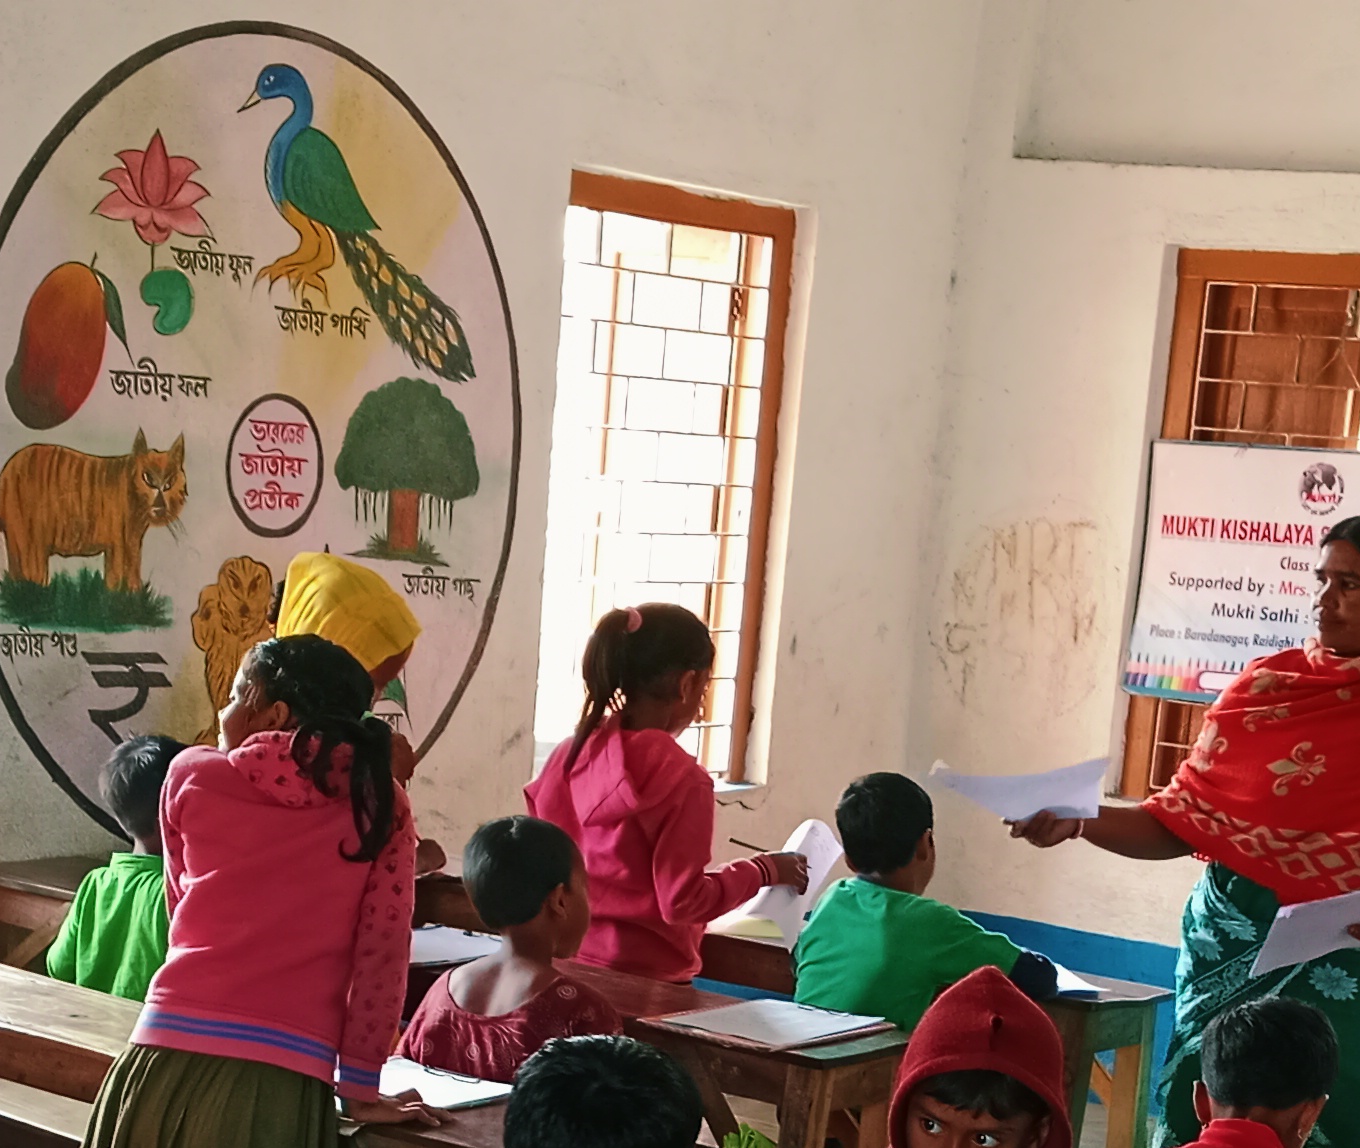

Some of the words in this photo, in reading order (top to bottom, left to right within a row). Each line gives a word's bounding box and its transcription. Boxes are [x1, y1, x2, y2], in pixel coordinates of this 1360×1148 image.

[169, 238, 226, 277] জাতীয়
[274, 298, 328, 337] জাতীয়
[108, 356, 176, 401] জাতীয়
[177, 373, 213, 398] ফল
[248, 418, 309, 445] ভারতের
[238, 444, 309, 479] জাতীয়
[242, 481, 305, 511] প্রতীক
[1161, 514, 1216, 539] MUKTI
[1219, 518, 1315, 546] KISHALAYA
[1279, 556, 1310, 572] Class
[401, 565, 451, 599] জাতীয়
[1168, 571, 1243, 592] Supported
[1247, 576, 1266, 596] by
[1211, 602, 1255, 621] Mukti
[1258, 606, 1300, 624] Sathi
[1150, 623, 1175, 640] Place
